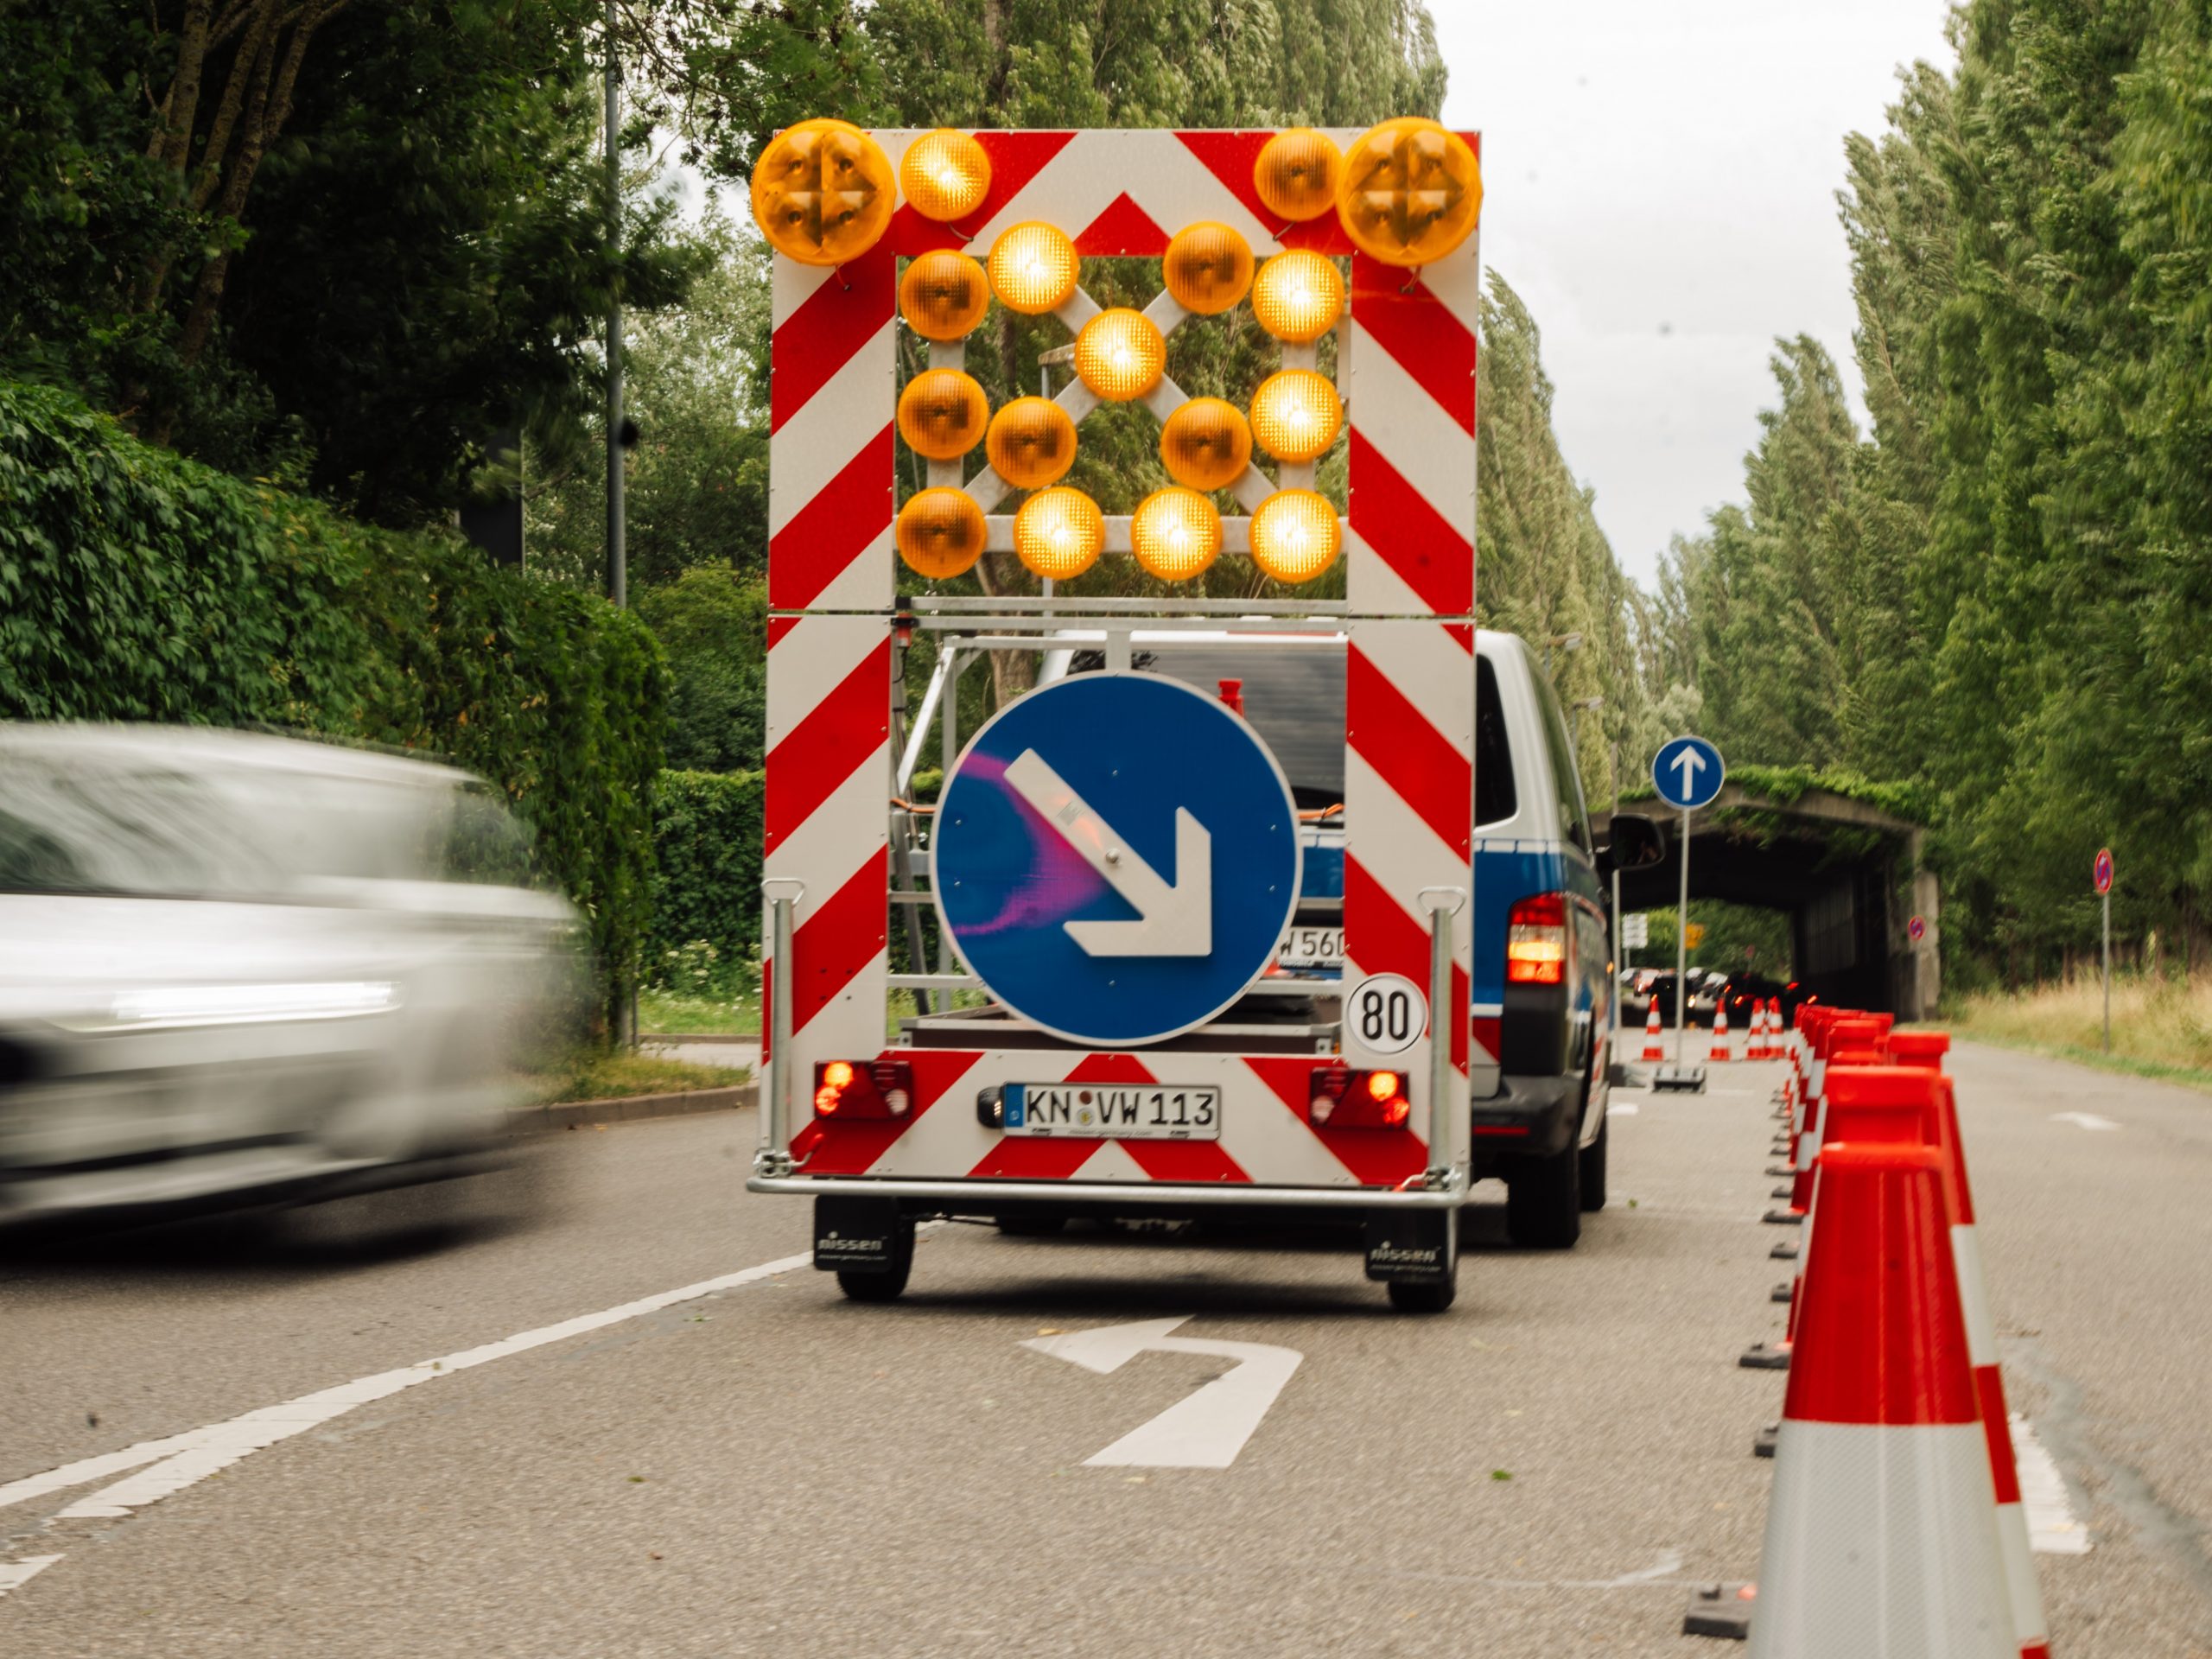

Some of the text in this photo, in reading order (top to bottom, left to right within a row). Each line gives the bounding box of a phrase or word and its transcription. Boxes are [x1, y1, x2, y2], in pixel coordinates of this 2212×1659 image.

[1363, 991, 1408, 1040] 80
[1027, 1090, 1214, 1125] KN VW 113
